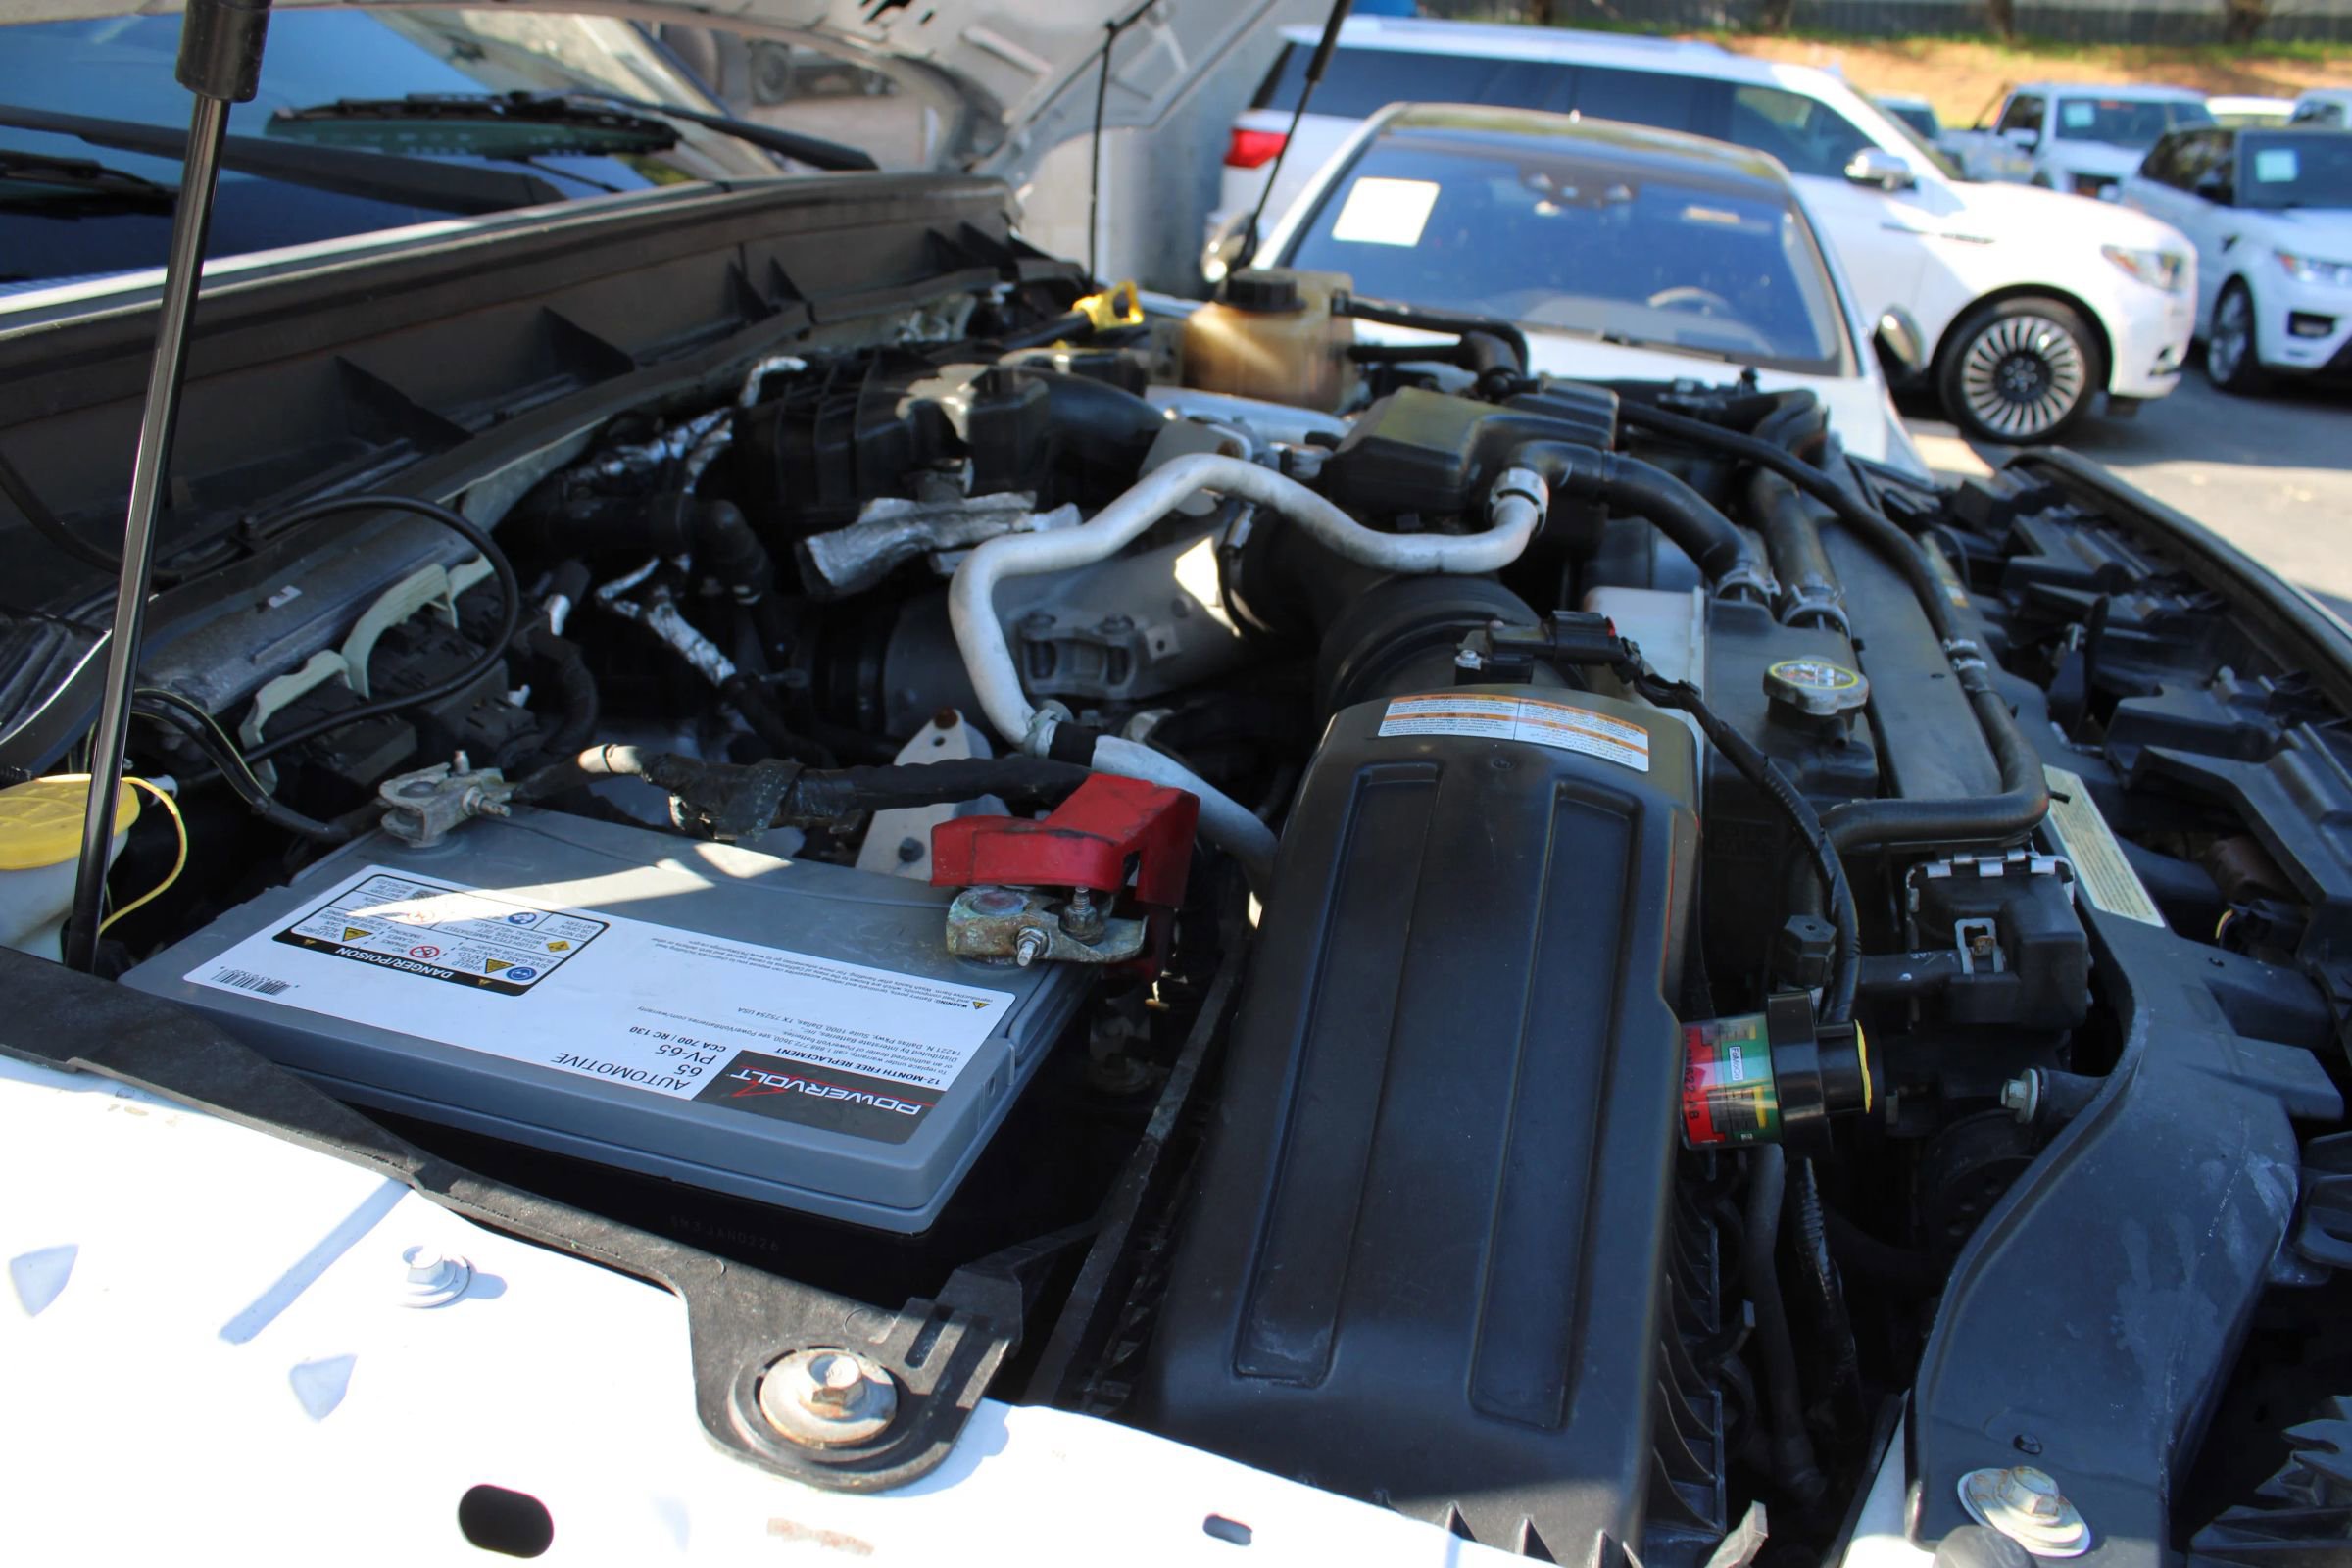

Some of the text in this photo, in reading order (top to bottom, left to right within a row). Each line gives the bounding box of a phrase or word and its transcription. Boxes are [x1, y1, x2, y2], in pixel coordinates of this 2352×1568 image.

[333, 947, 455, 978] DANGER/POISON
[497, 955, 529, 963] GASES
[450, 960, 483, 970] SHIELD
[754, 1011, 782, 1020] 75254
[627, 1026, 652, 1035] 130
[675, 1036, 700, 1046] 700
[815, 1039, 856, 1050] PowerVolt
[858, 1040, 899, 1051] Interstate
[895, 1039, 923, 1049] Dallas
[699, 1042, 727, 1052] CCA
[935, 1047, 961, 1055] 14221
[653, 1043, 717, 1064] PV-65
[910, 1050, 958, 1062] Distributed
[889, 1054, 931, 1064] authorized
[1730, 1047, 1741, 1080] FoMoCo
[672, 1063, 705, 1078] 65
[774, 1047, 941, 1084] 12-MONTH FREE REPLACEMENT
[907, 1062, 937, 1072] replace
[549, 1052, 690, 1092] AUTOMOTIVE
[728, 1066, 922, 1115] POWERVOLT
